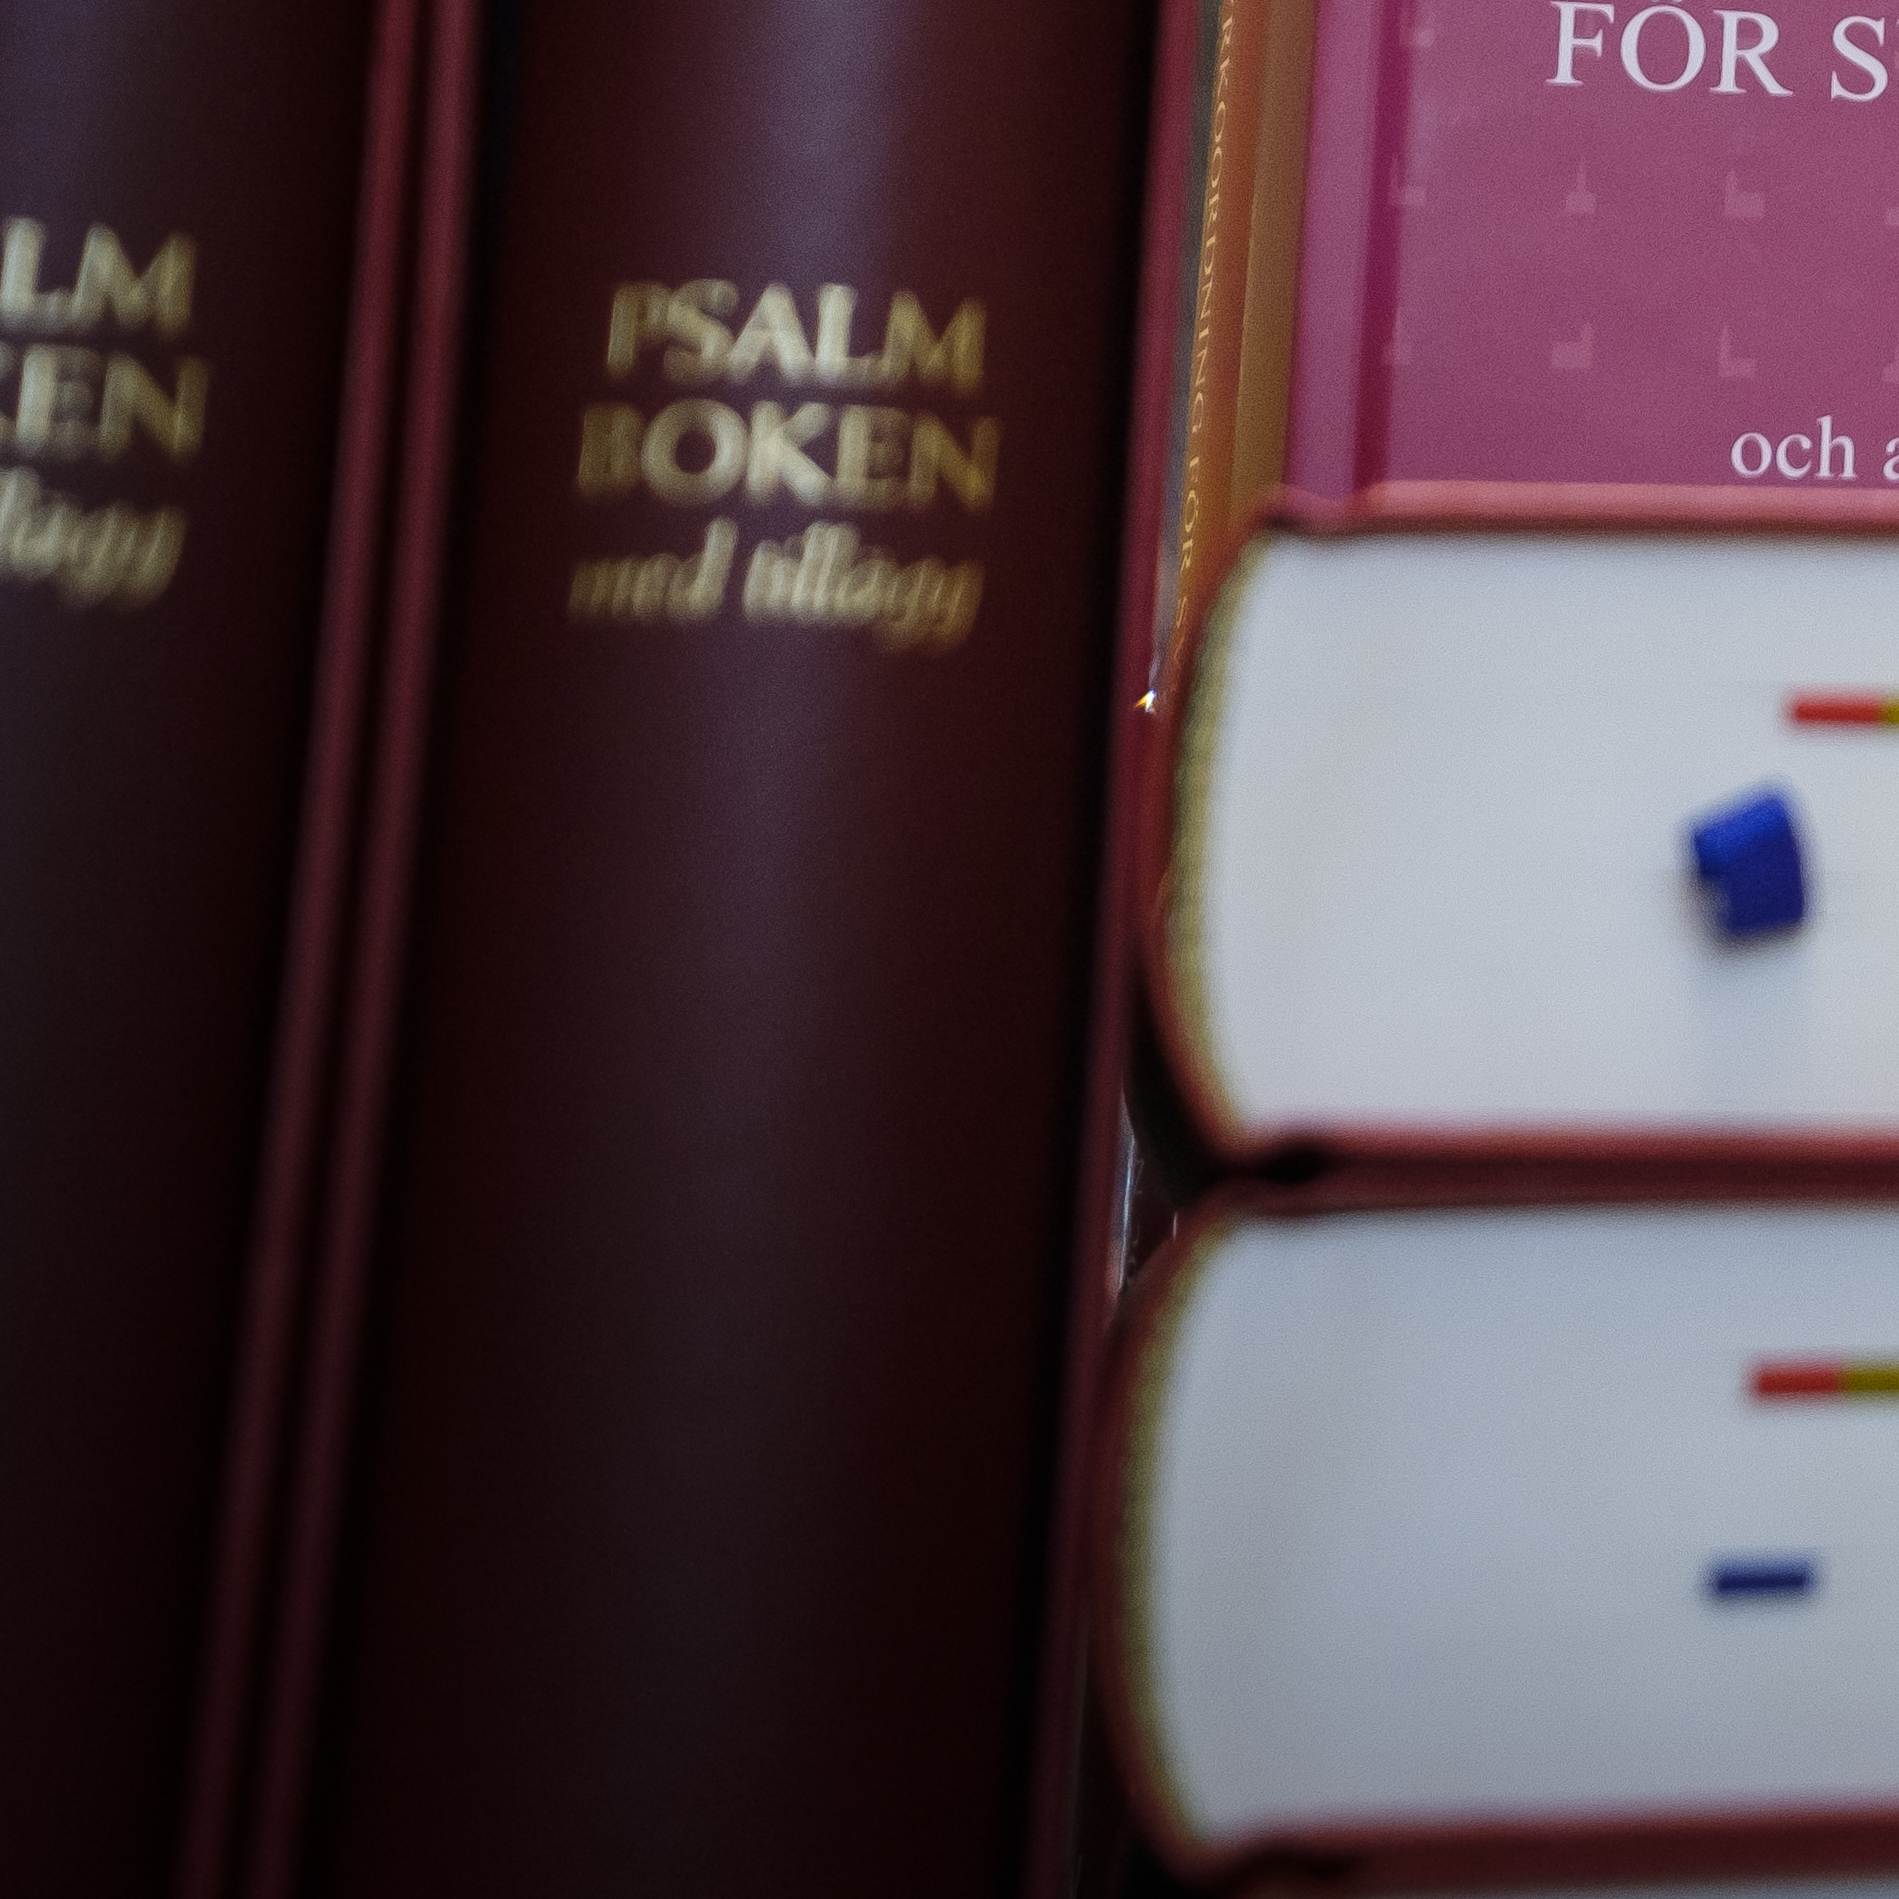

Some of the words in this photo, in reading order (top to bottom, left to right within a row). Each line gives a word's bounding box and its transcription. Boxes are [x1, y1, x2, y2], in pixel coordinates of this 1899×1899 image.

[607, 276, 987, 396] PSALM
[577, 398, 999, 514] BOKEN
[1730, 414, 1857, 480] och
